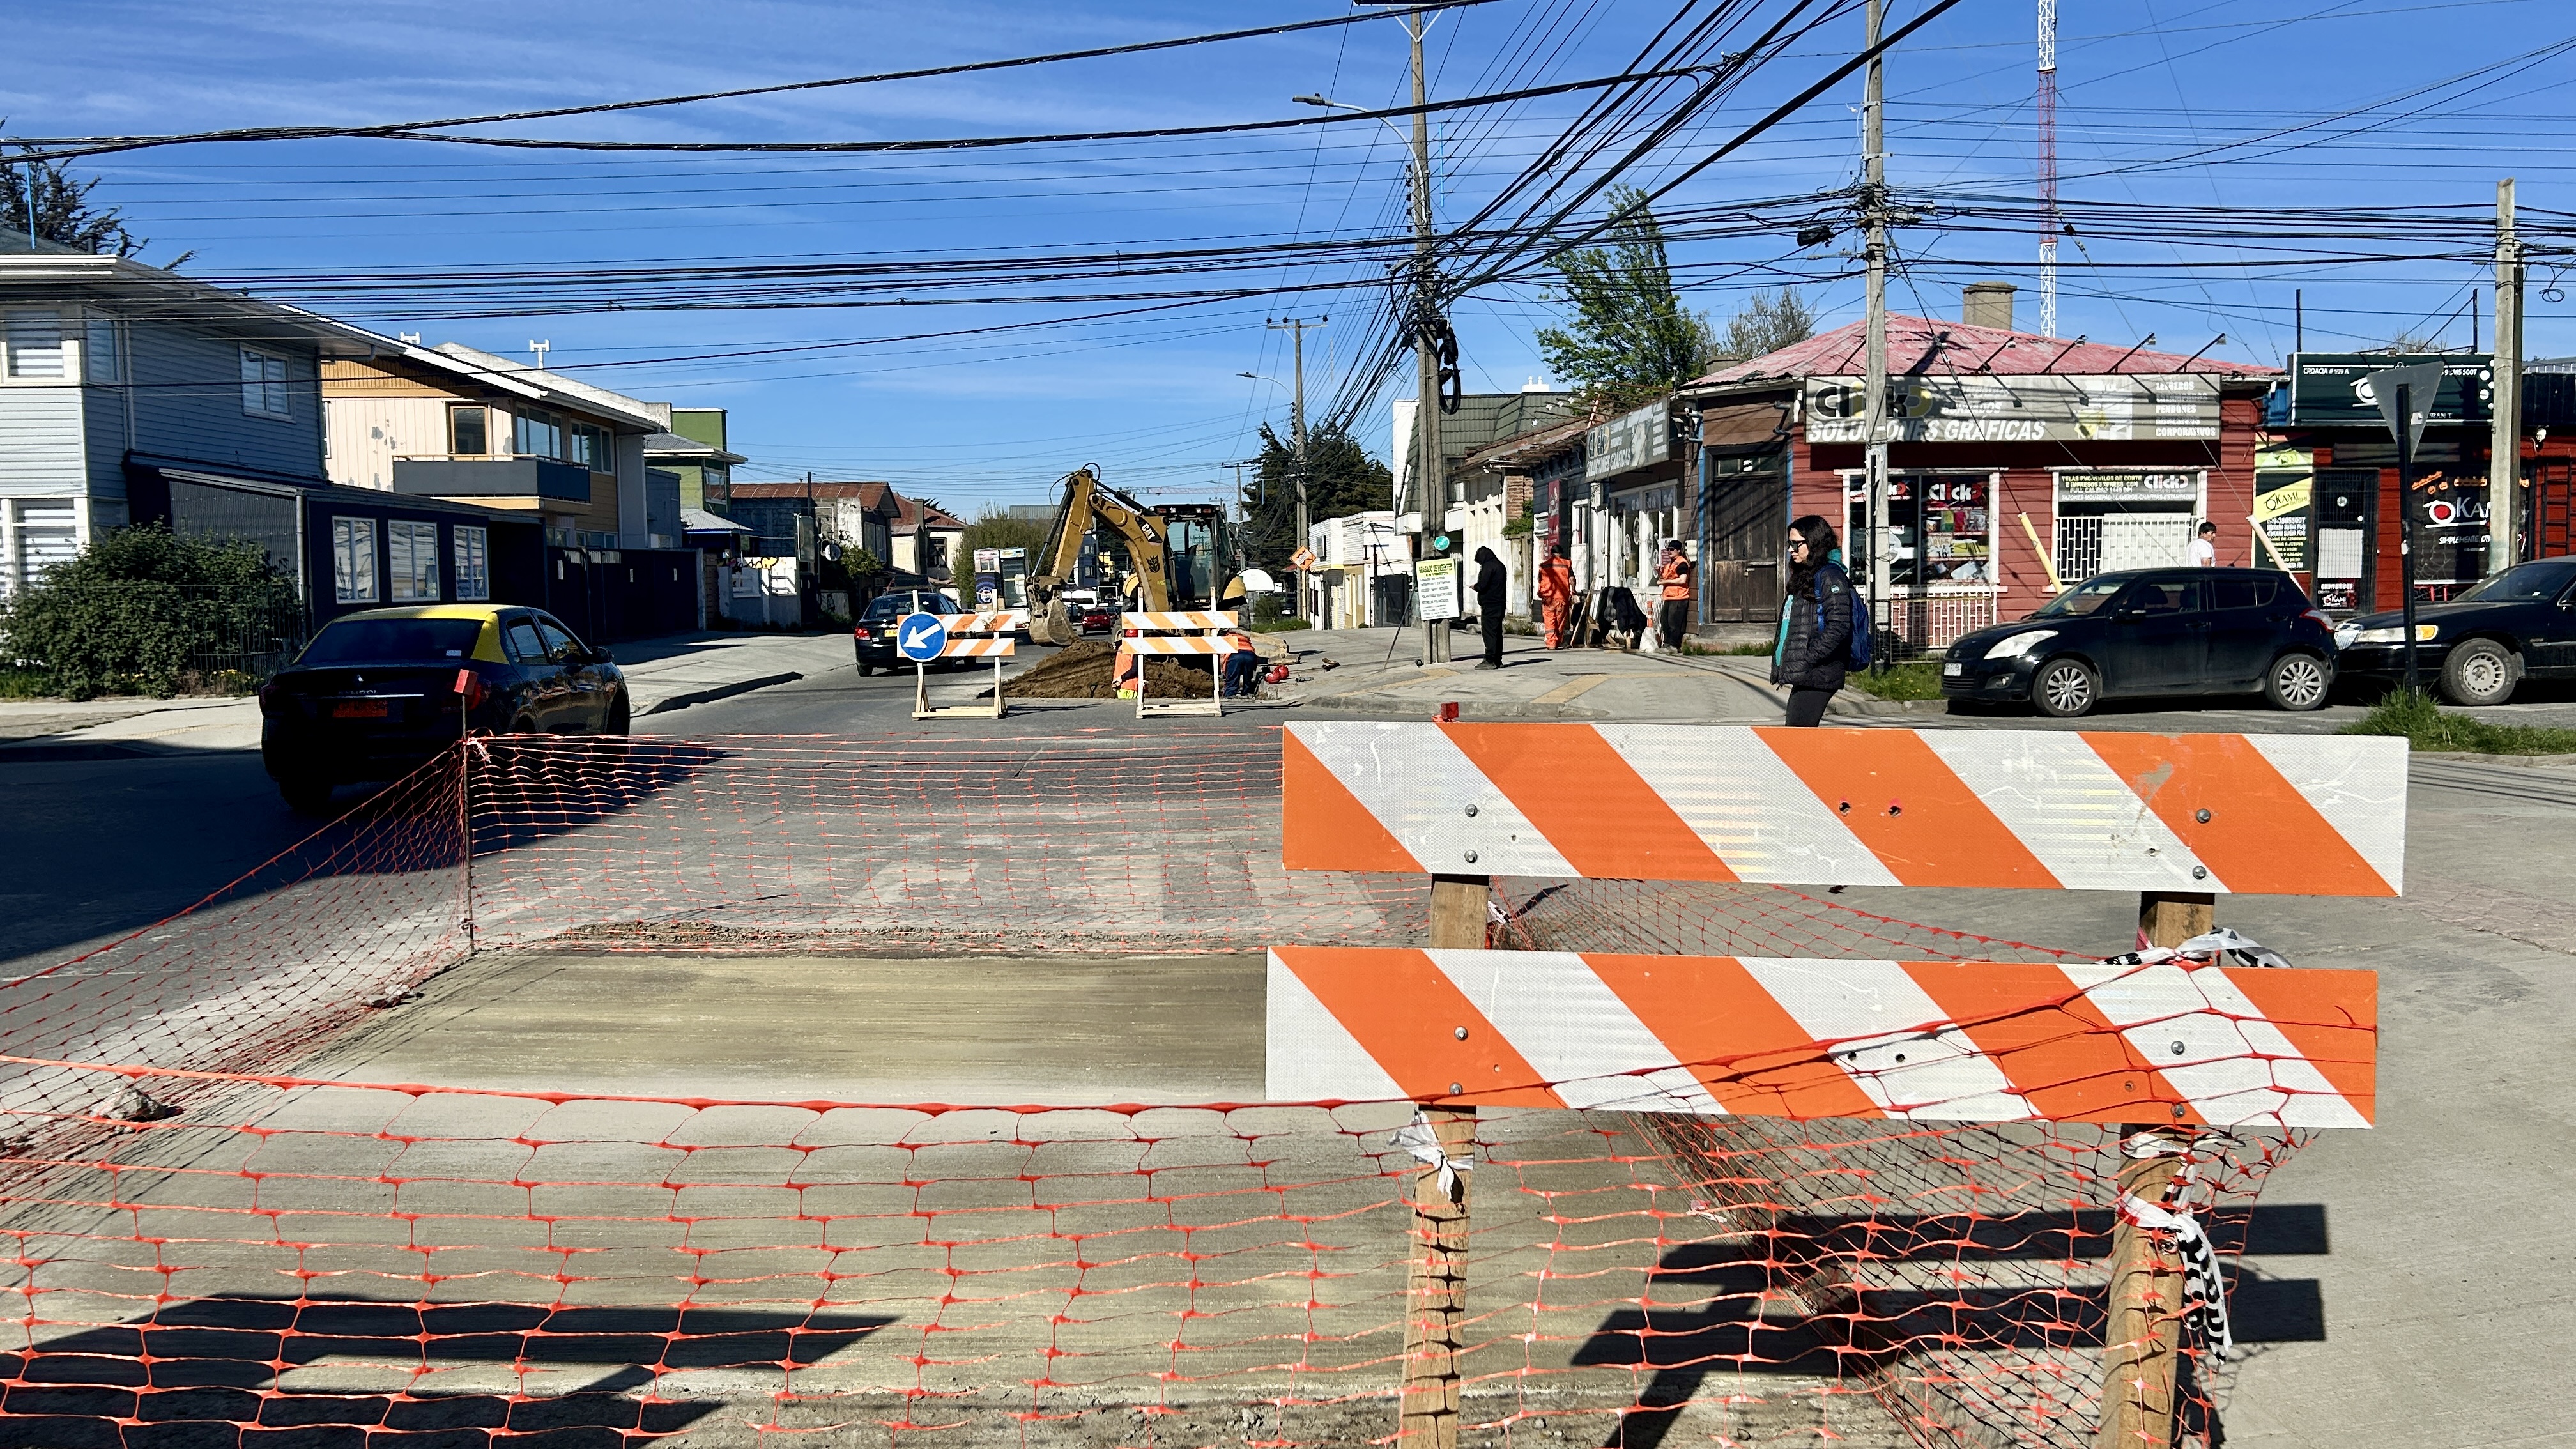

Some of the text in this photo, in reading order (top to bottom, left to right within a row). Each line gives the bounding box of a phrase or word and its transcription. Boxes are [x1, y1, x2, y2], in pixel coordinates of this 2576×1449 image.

[2156, 404, 2196, 414] PENDONES
[1808, 420, 1938, 442] SOLUONES
[2156, 427, 2216, 437] CORPORATIVOS
[1141, 523, 1156, 540] CAT
[2439, 535, 2479, 544] SIMPLEMENTE
